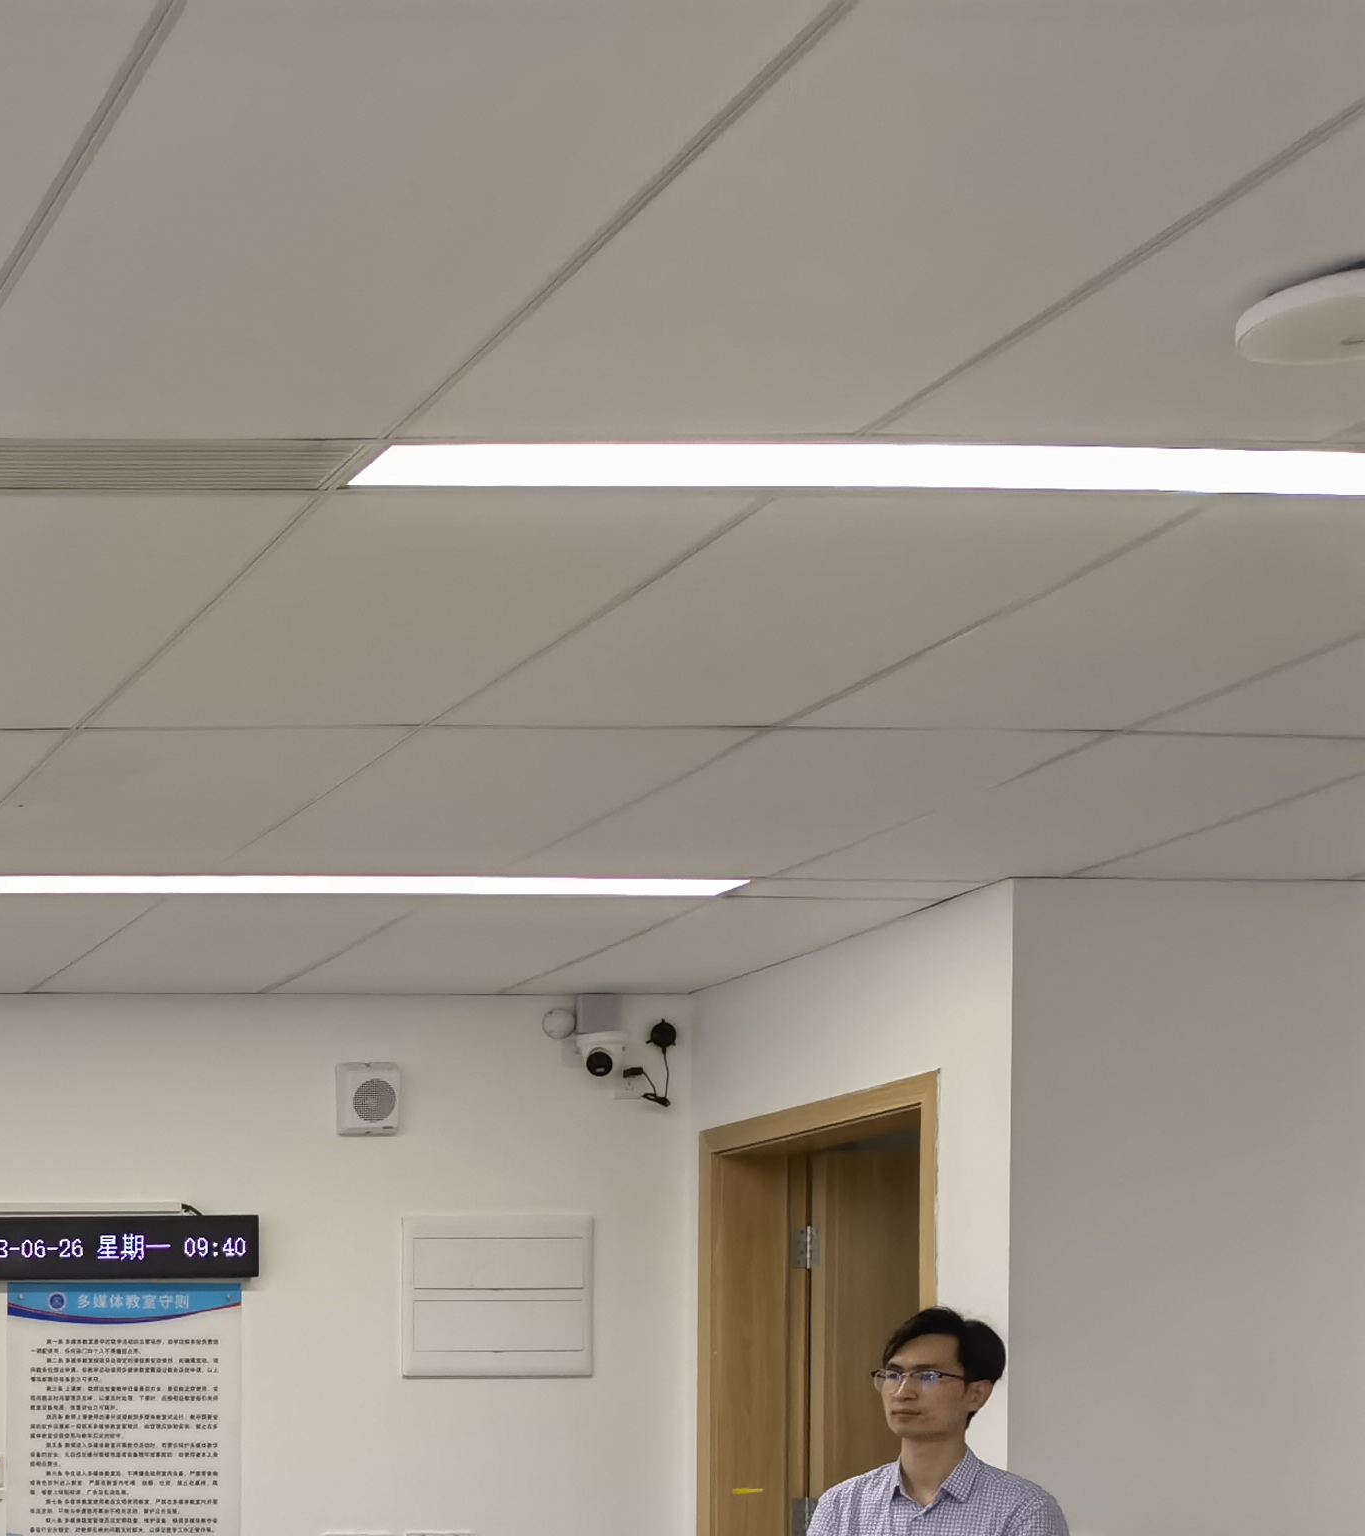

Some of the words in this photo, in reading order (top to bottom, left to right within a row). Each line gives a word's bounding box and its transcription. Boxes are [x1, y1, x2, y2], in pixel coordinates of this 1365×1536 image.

[97, 1233, 171, 1261] 星期一
[183, 1237, 247, 1257] 09:40
[76, 1293, 190, 1310] 多媒体教室守则
